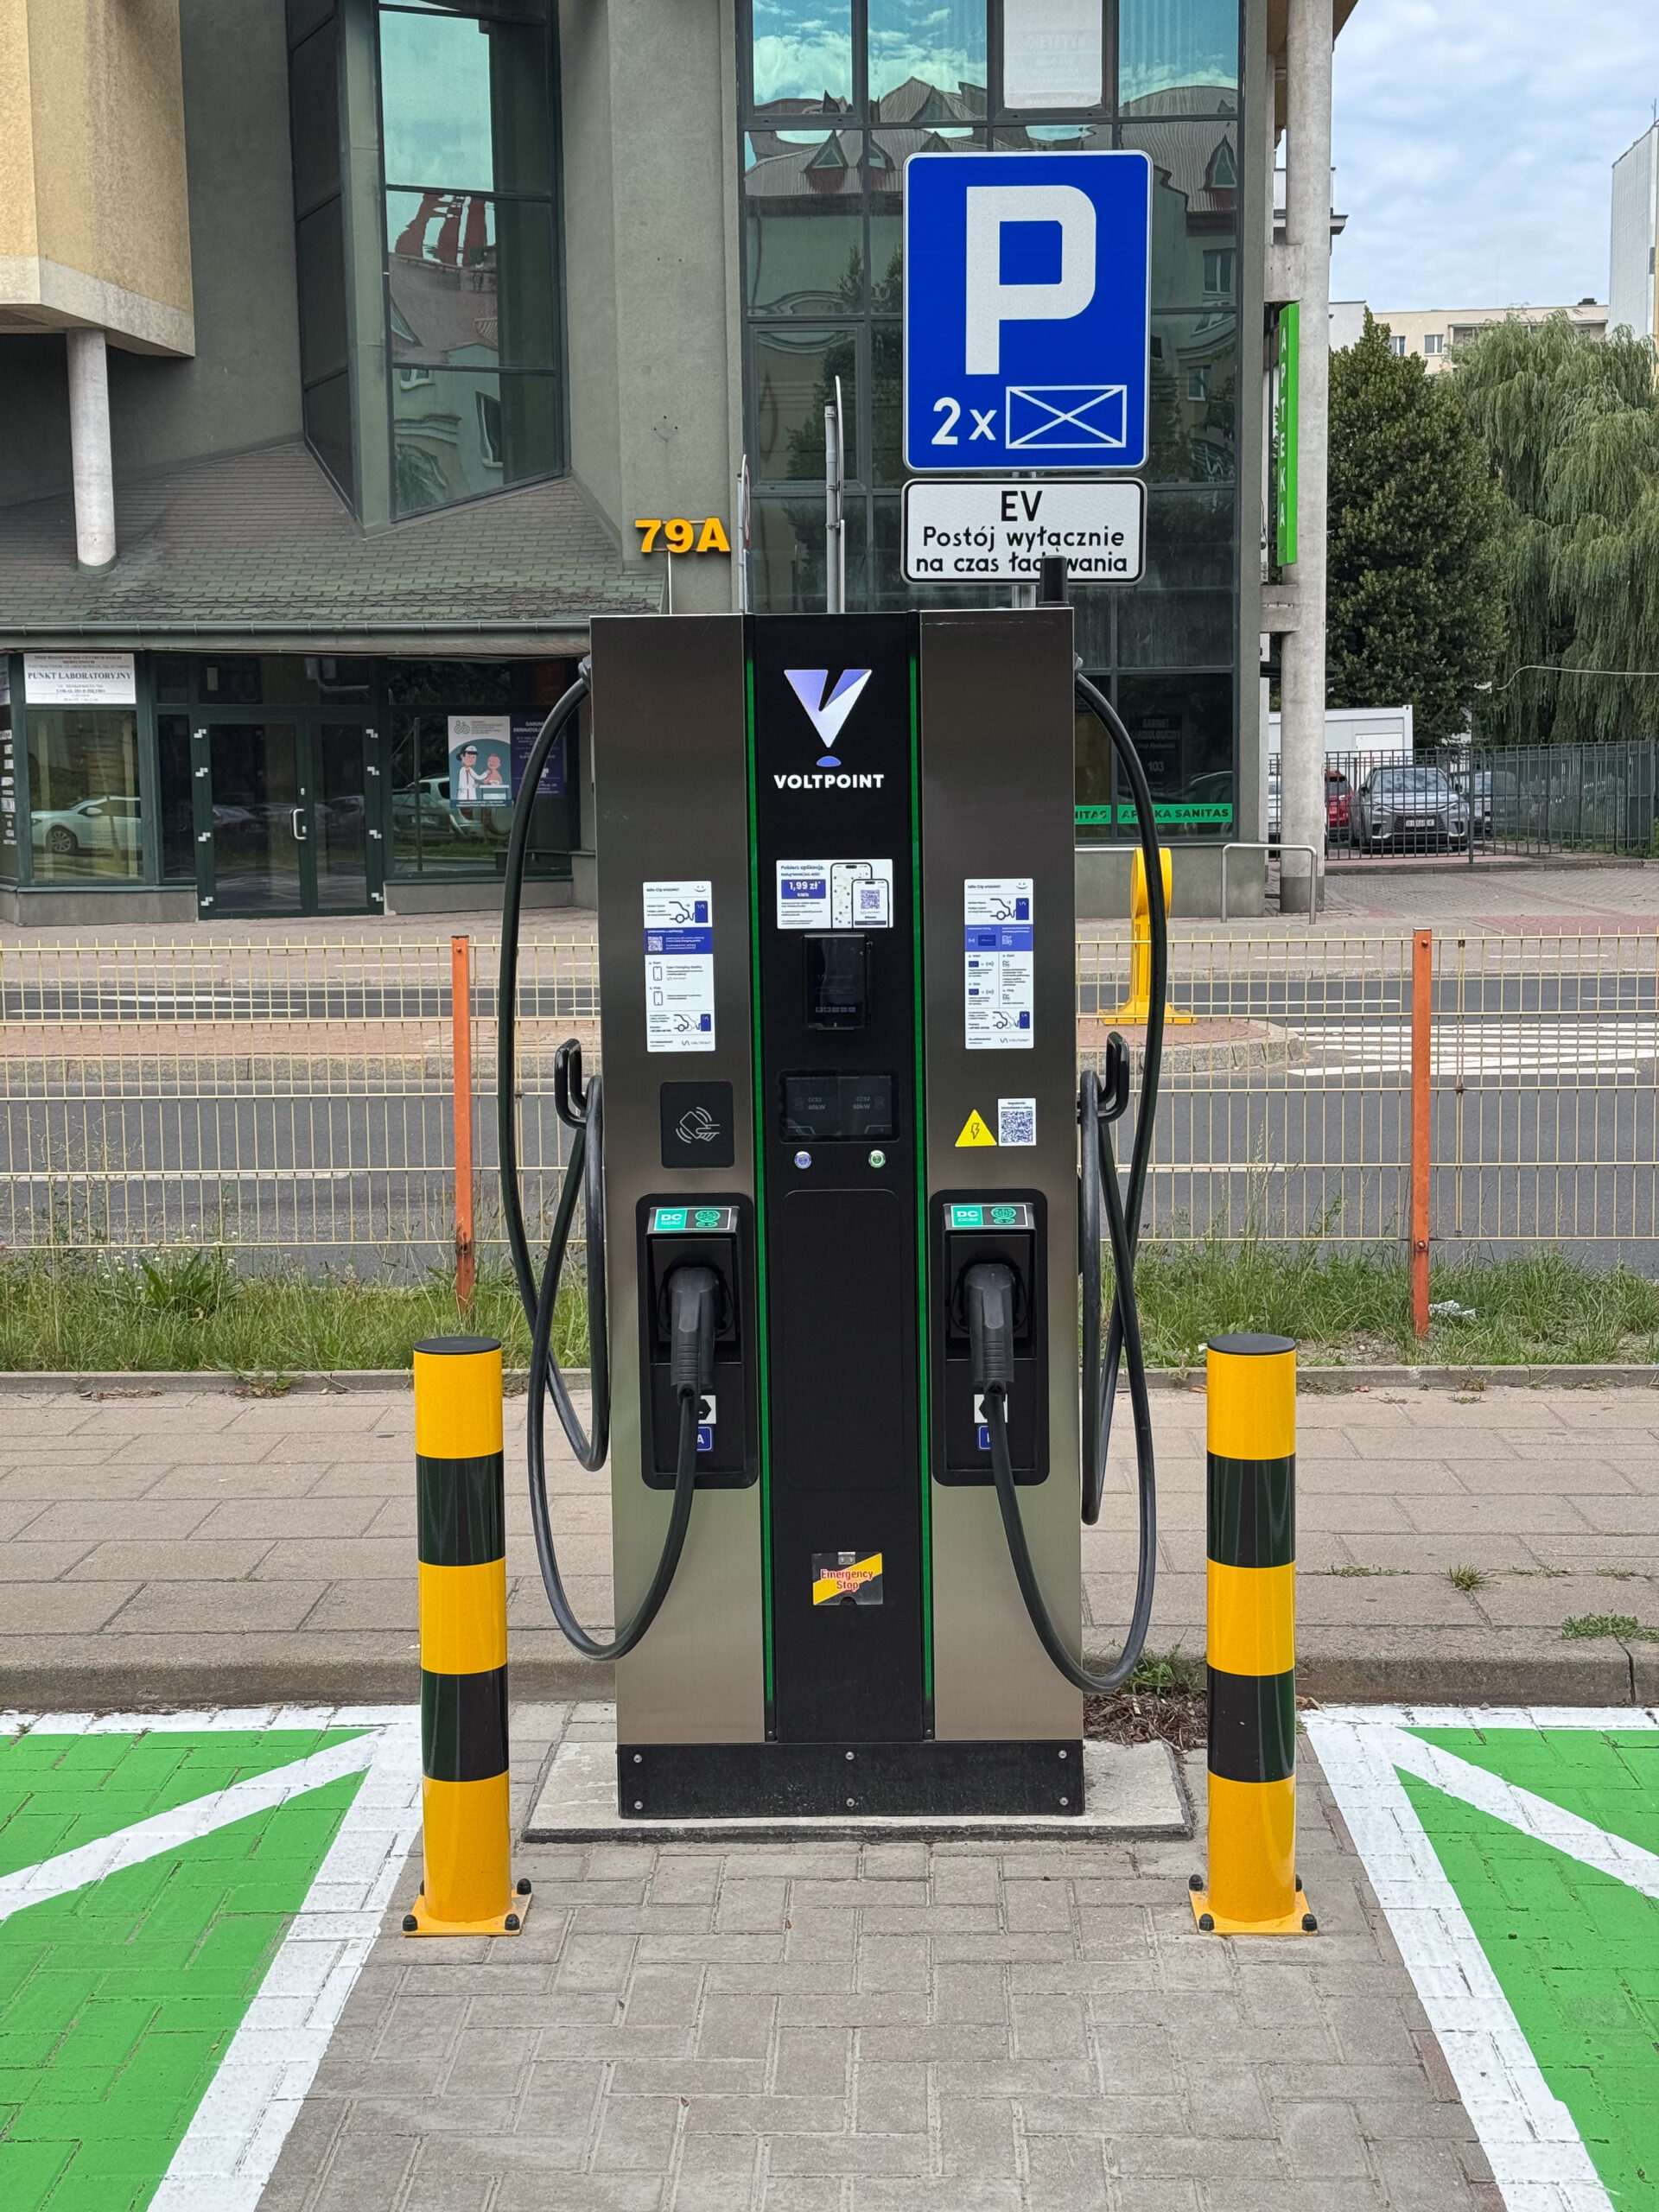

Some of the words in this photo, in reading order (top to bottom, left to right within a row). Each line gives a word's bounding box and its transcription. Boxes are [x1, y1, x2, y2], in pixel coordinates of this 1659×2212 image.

[965, 185, 1097, 375] P
[1000, 490, 1044, 523] EV
[635, 517, 731, 553] 79A
[923, 525, 995, 553] Postój
[1006, 525, 1124, 553] wyłącznie
[916, 557, 944, 573] na
[953, 557, 1000, 573] czas
[1007, 551, 1128, 573] ładwania
[58, 671, 132, 680] LABORATORYJNY
[1147, 761, 1165, 772] 103
[773, 773, 885, 790] VOLTPOINT
[1075, 810, 1108, 819] ITAS
[1121, 809, 1172, 819] APKA
[1174, 808, 1230, 818] SANITAS
[789, 881, 808, 892] 1,99
[821, 1569, 874, 1580] Emergency
[836, 1580, 859, 1591] Stop
